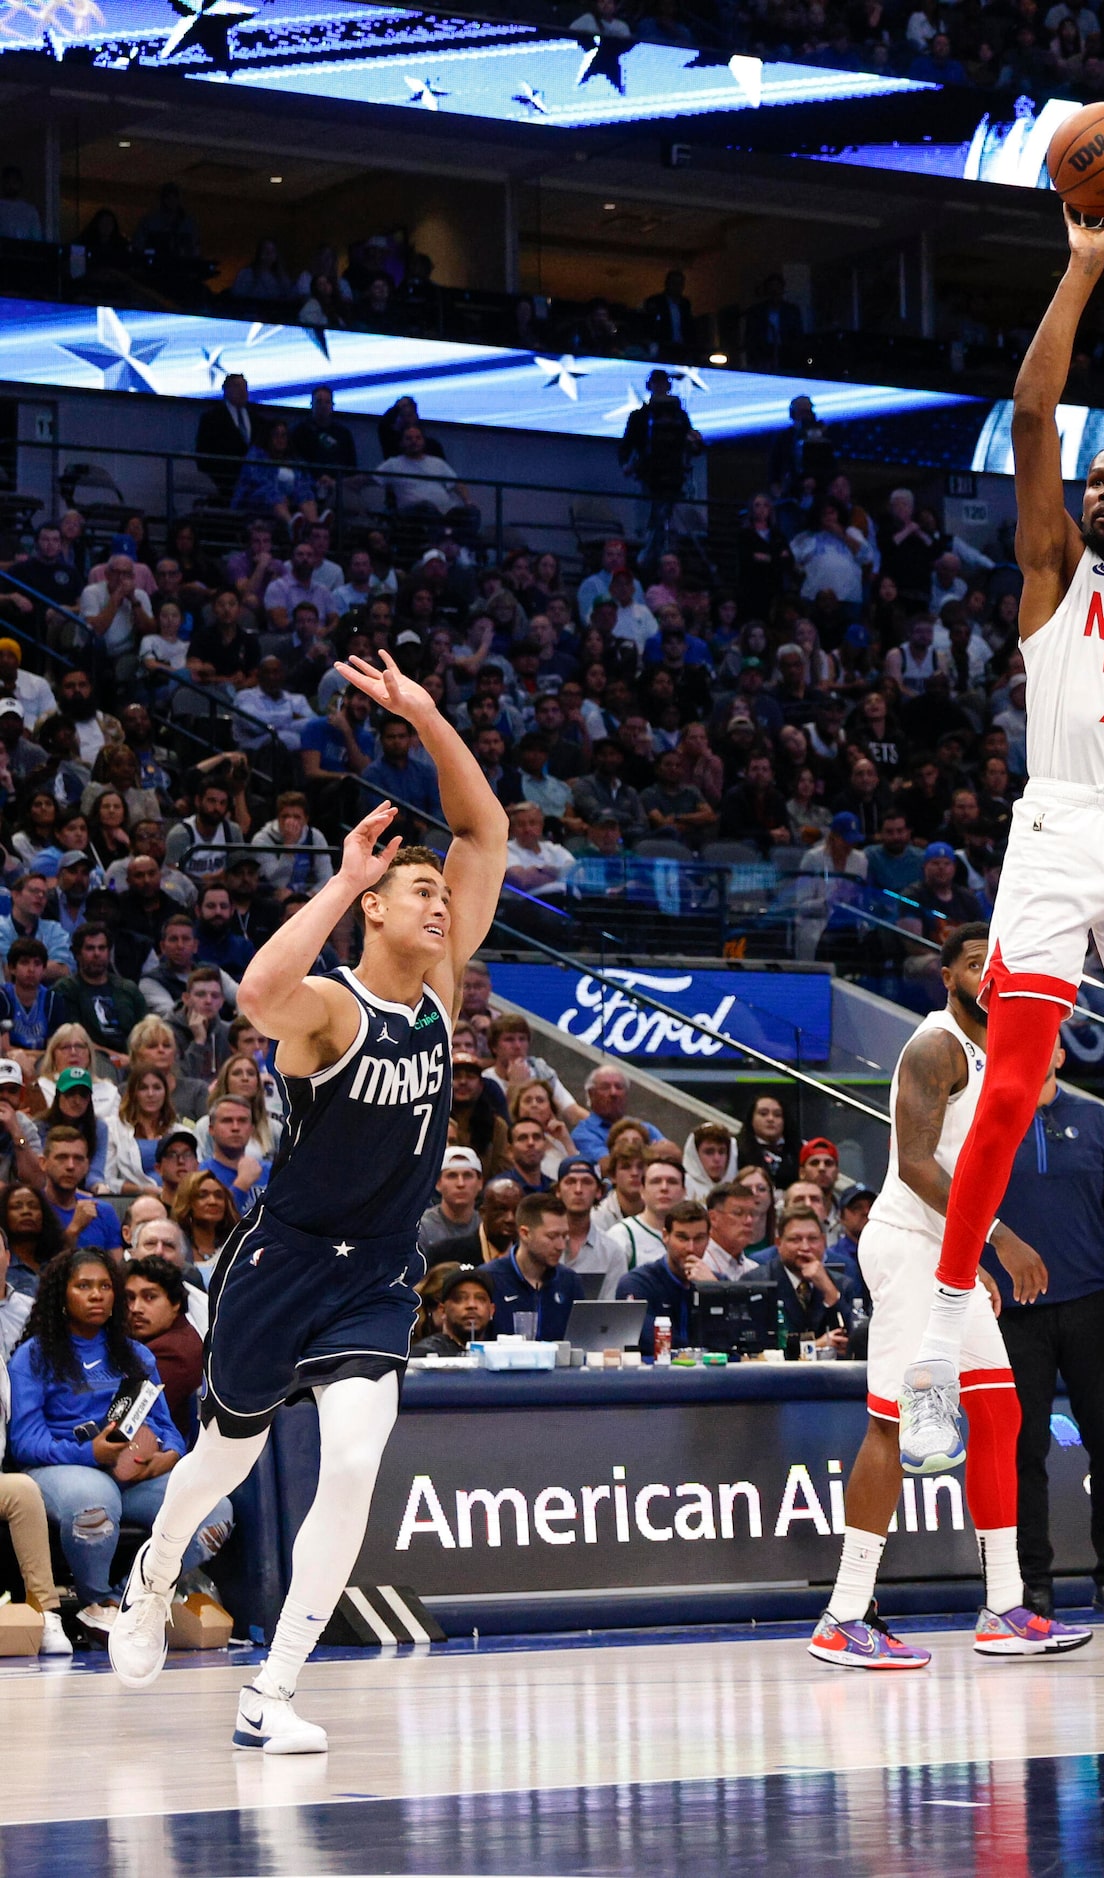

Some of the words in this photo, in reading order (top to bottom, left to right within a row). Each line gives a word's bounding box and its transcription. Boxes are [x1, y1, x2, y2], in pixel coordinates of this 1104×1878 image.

[868, 741, 898, 764] ETS
[557, 968, 736, 1056] Ford
[348, 1042, 444, 1106] MAVS
[413, 1103, 433, 1156] 7
[132, 1398, 148, 1423] POPCORN
[395, 1465, 763, 1550] American
